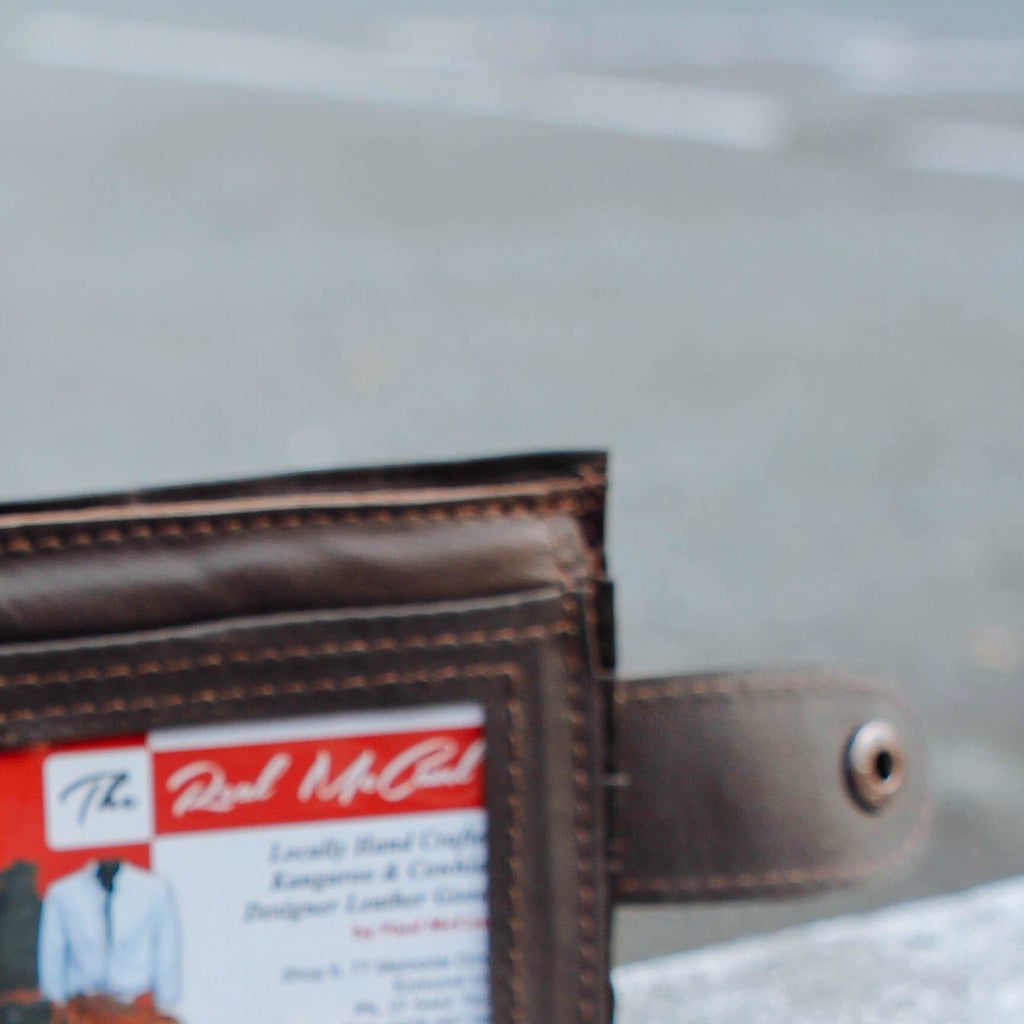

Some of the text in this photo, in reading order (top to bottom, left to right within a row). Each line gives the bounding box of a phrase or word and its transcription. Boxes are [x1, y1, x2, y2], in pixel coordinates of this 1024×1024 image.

[60, 767, 138, 828] The
[166, 751, 293, 820] Real
[267, 837, 346, 864] Locally
